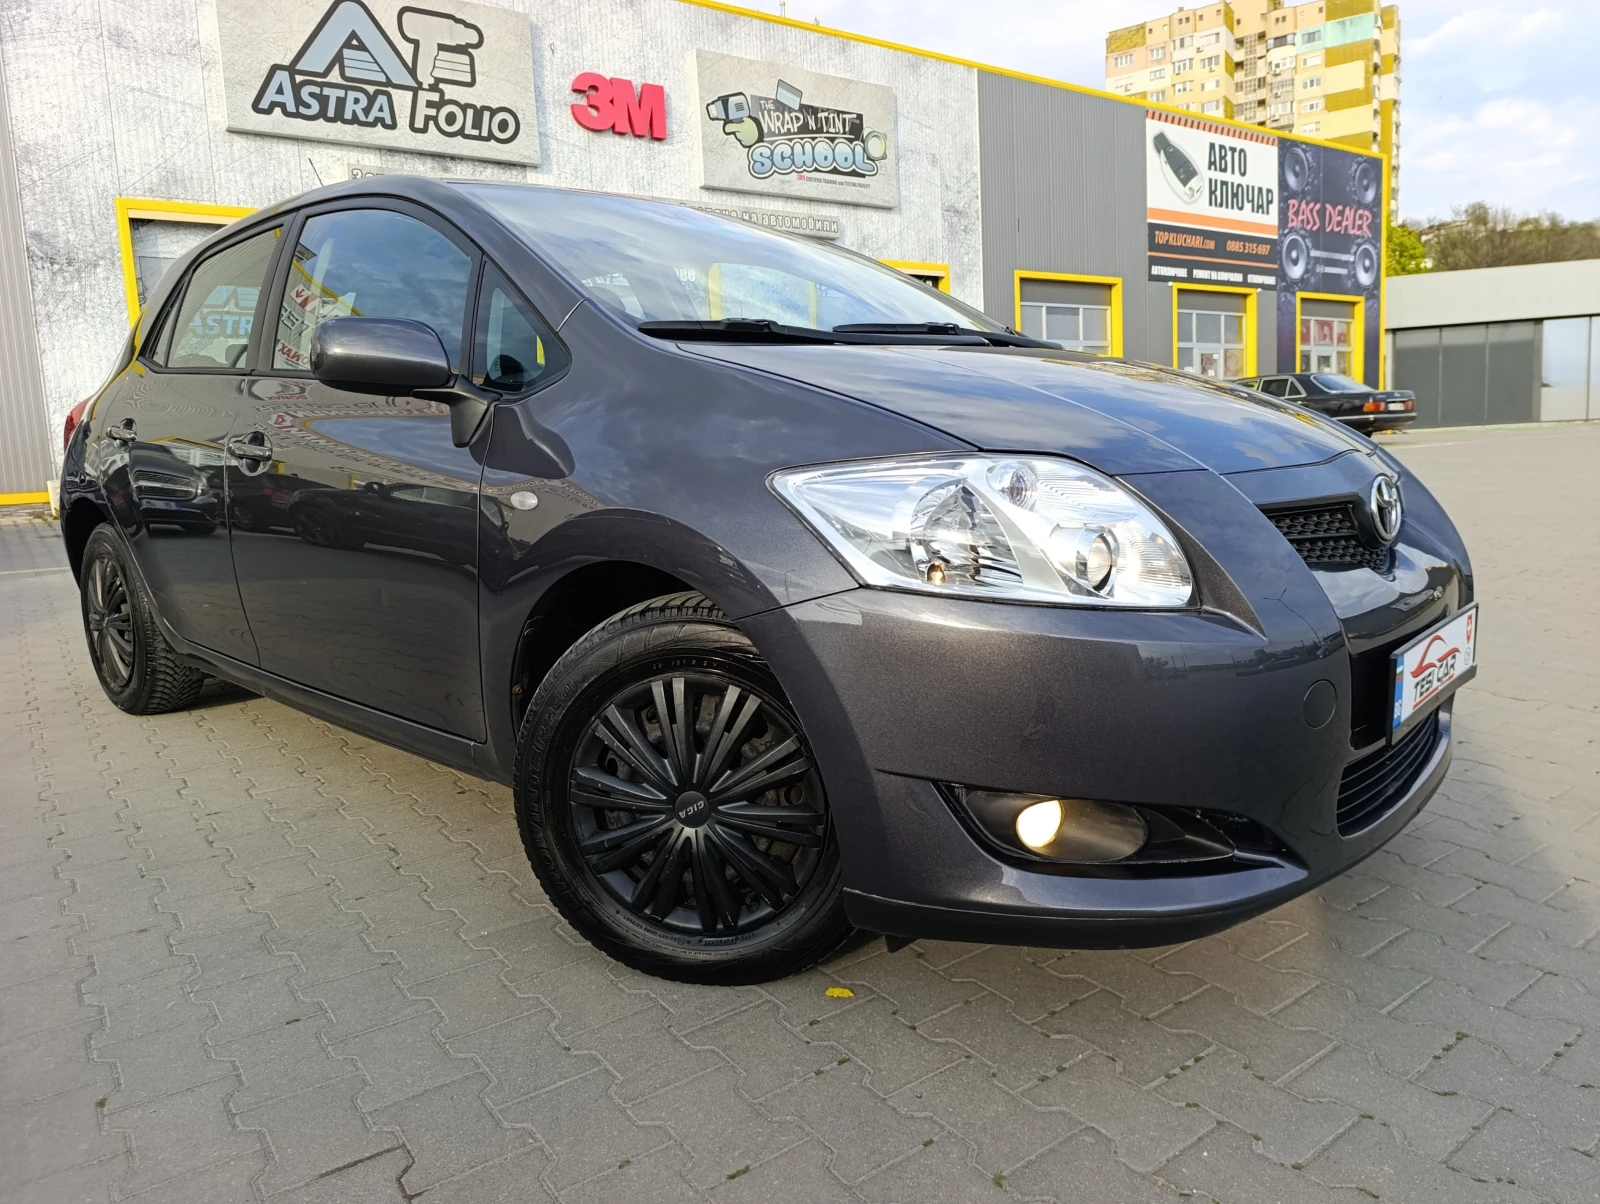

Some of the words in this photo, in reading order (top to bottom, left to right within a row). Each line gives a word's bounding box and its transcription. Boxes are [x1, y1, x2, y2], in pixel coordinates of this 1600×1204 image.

[253, 66, 397, 128] ASTRA
[410, 86, 519, 143] FOLIO
[571, 72, 667, 140] 3M
[759, 111, 804, 134] WRAP
[817, 112, 857, 134] TINT
[760, 100, 775, 110] THE
[749, 141, 877, 178] SCHOOL
[1208, 142, 1247, 177] АВТО
[1208, 178, 1273, 215] КЛЮЧАР
[763, 213, 839, 233] автомобили
[1288, 199, 1321, 231] BASS
[1325, 203, 1372, 237] DEALER
[679, 800, 704, 818] GIGA
